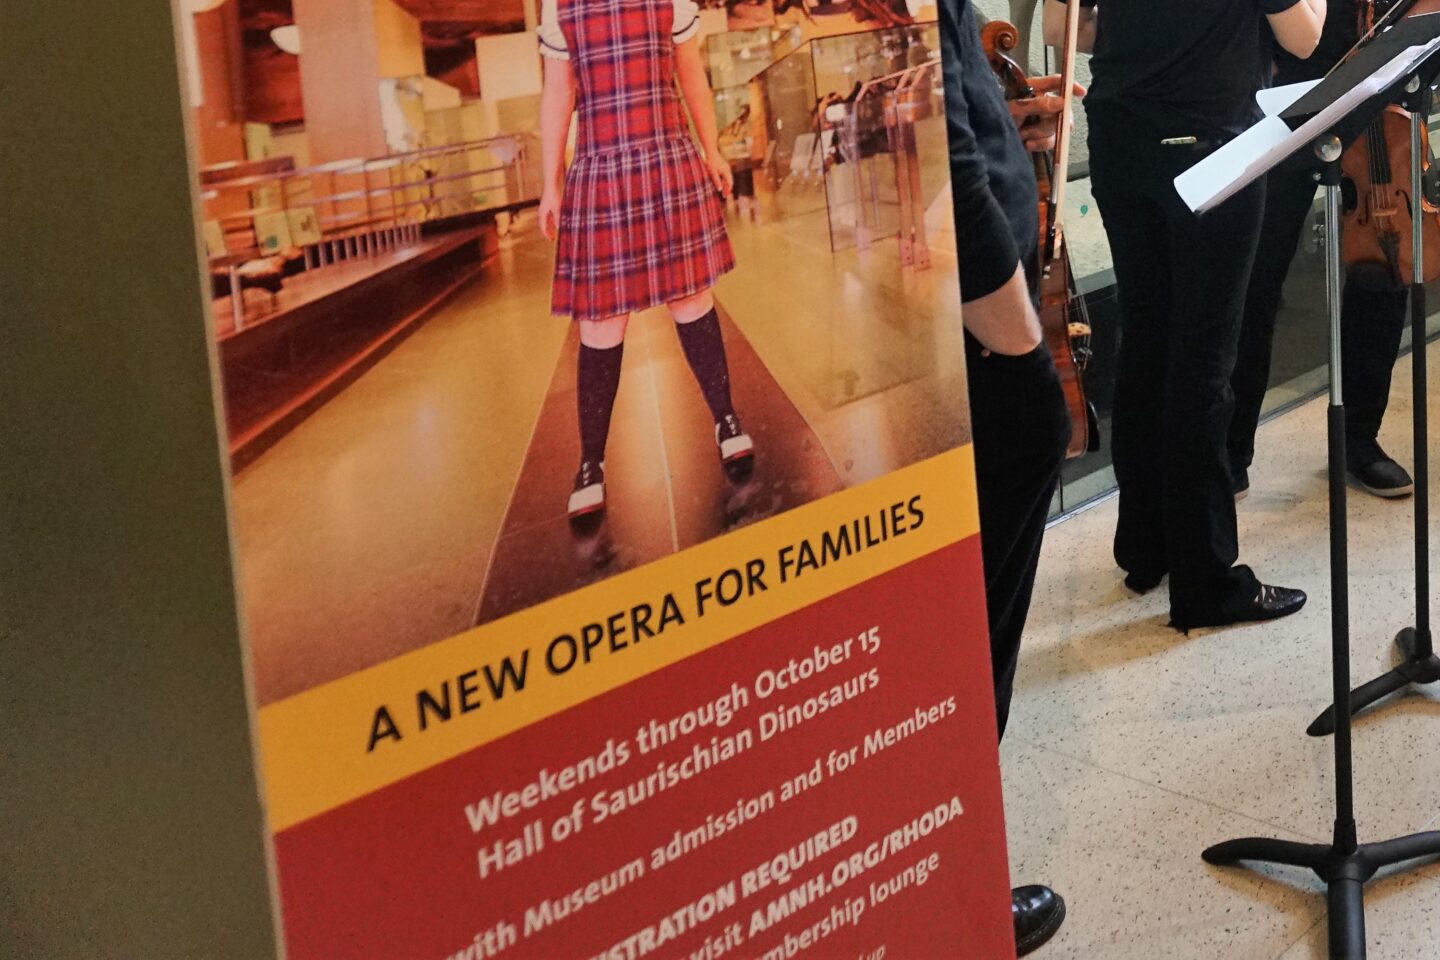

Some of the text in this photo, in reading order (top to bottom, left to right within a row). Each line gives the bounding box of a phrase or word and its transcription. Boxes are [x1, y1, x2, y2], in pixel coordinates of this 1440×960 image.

[366, 494, 925, 754] A NEW OPERA FOR FAMILIES
[464, 625, 882, 834] Weekends through October 15
[477, 666, 880, 880] Hall of Saurischian Dinosaurs
[523, 856, 646, 939] Museum
[650, 790, 775, 871] admission
[780, 757, 823, 803] and
[826, 746, 859, 777] for
[862, 695, 957, 760] Members
[740, 814, 859, 899] REQUIRED
[748, 795, 964, 939] AMNH.ORG/RHODA
[869, 852, 940, 908] lounge
